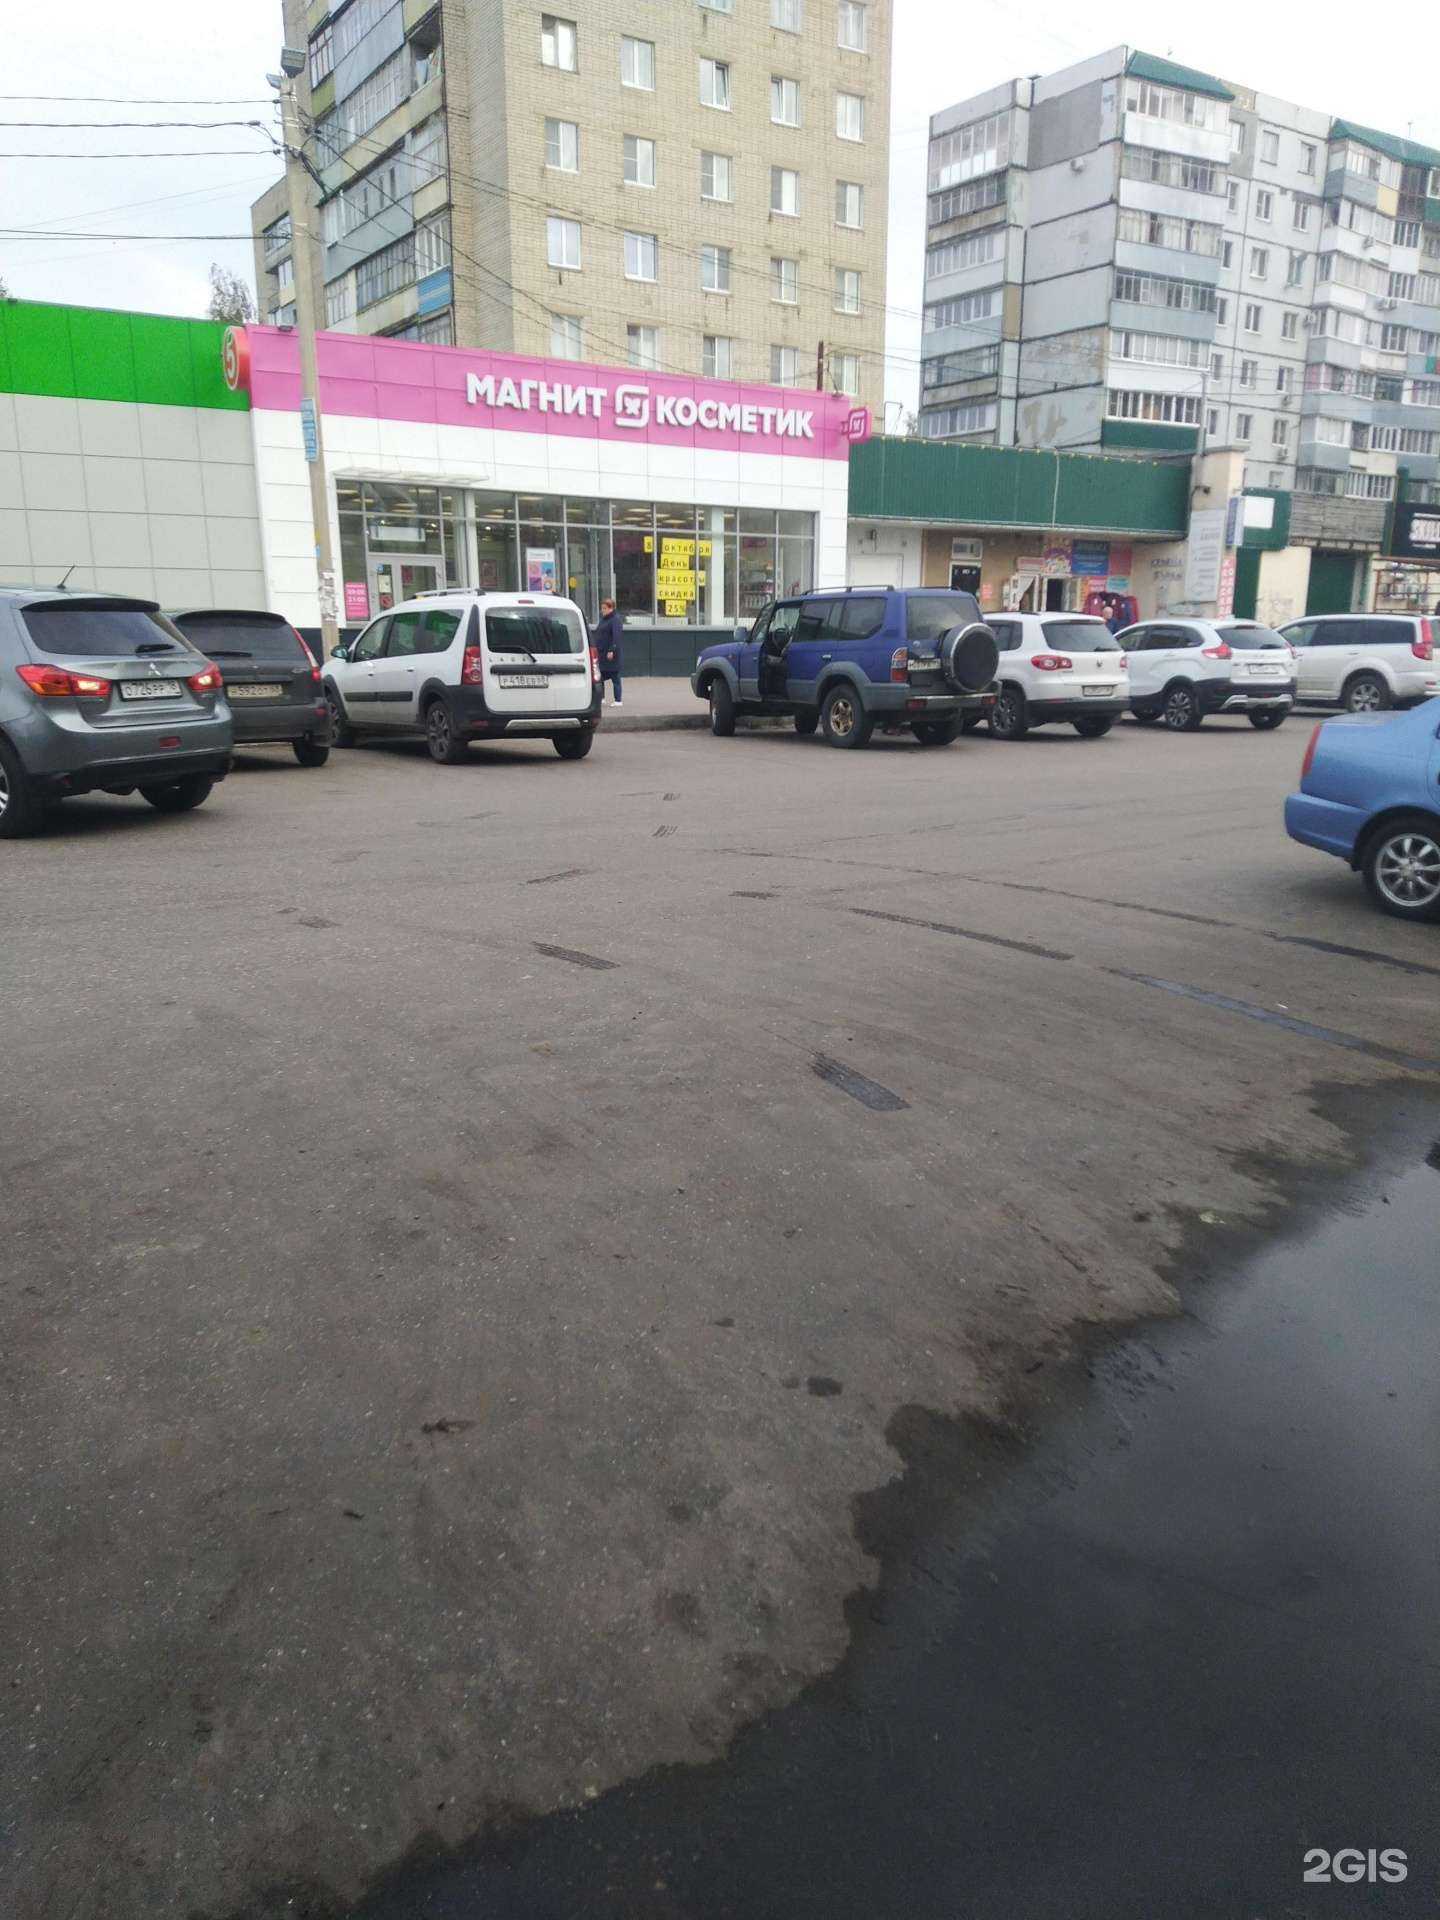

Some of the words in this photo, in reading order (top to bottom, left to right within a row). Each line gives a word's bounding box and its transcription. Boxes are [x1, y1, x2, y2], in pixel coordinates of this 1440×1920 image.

[465, 372, 608, 418] МАГНИТ
[655, 393, 814, 438] КОСМЕТИК
[662, 558, 688, 567] День
